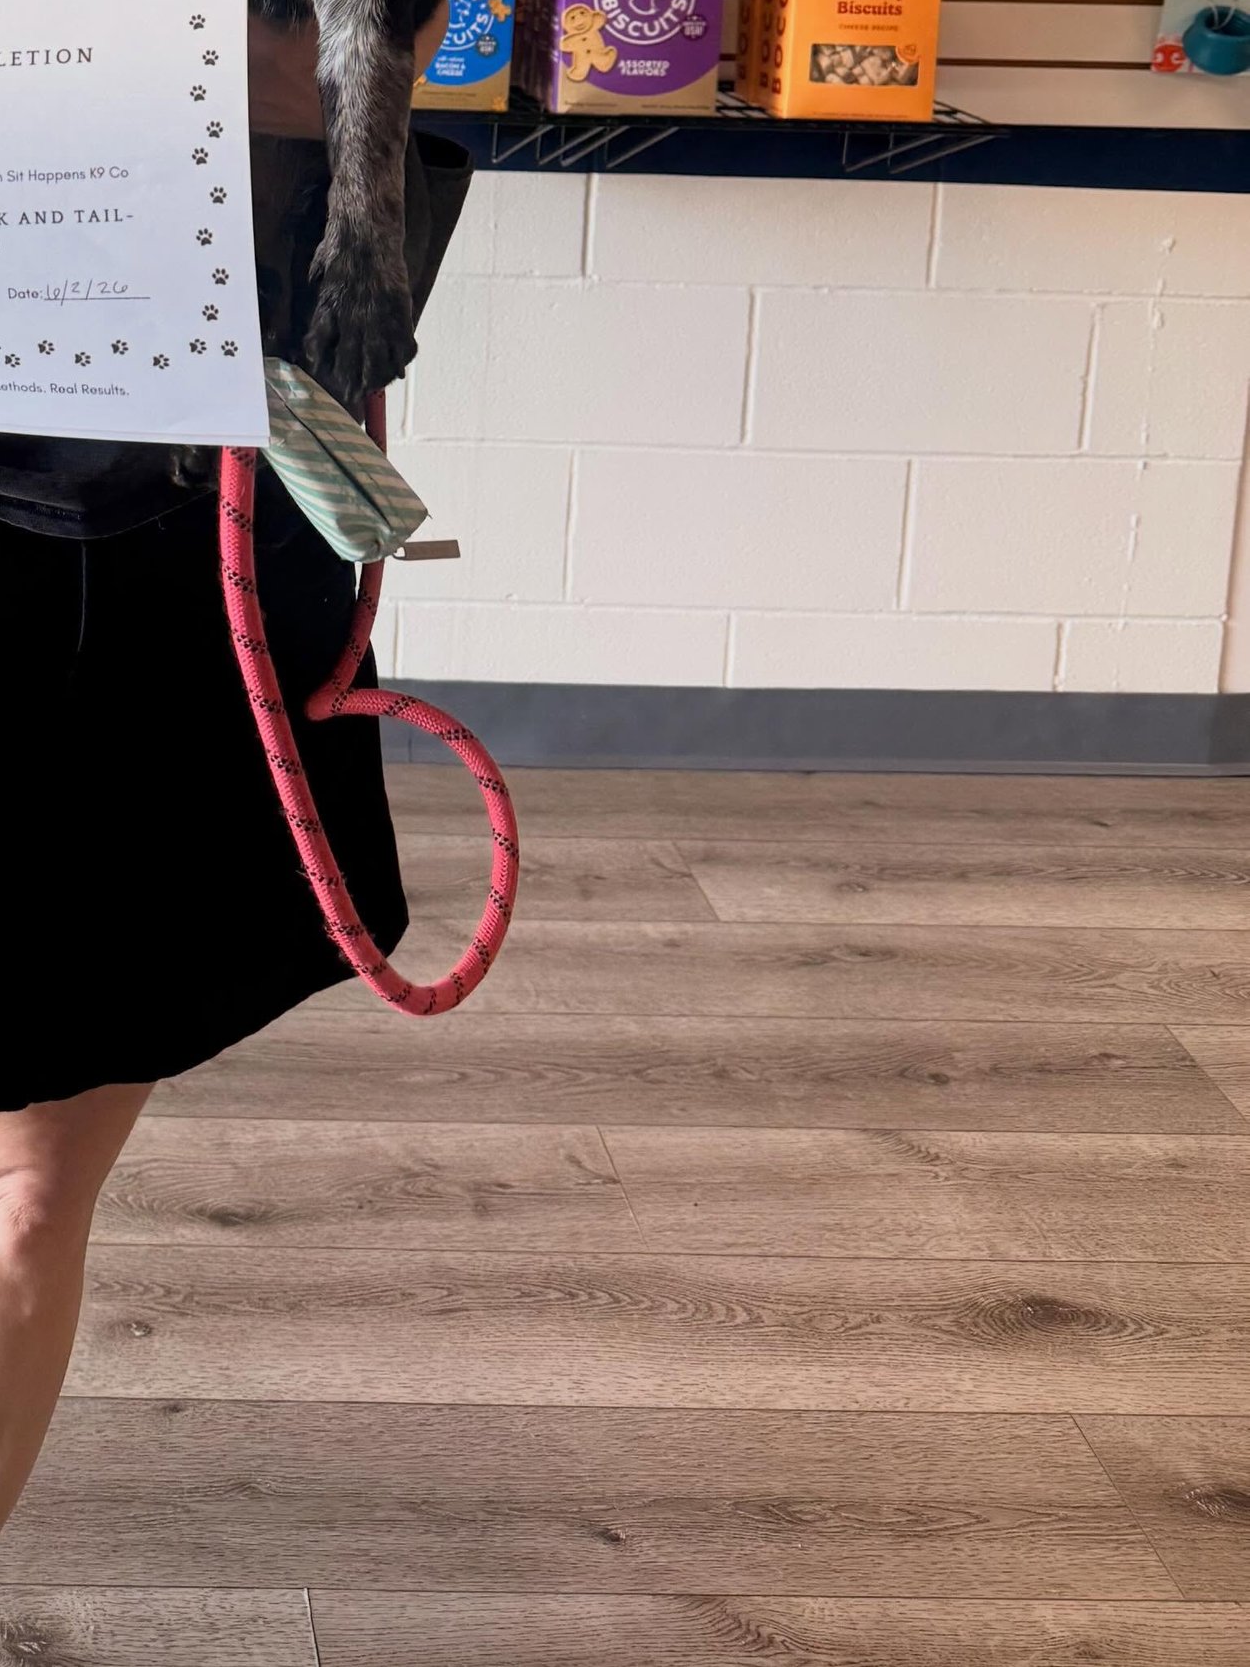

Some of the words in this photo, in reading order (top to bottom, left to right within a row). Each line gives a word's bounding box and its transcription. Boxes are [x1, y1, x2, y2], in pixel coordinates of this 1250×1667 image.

[837, 0, 902, 15] Biscuits
[442, 12, 489, 45] CUITS
[617, 59, 670, 69] ASSORTED
[620, 67, 667, 76] FLAVORS
[6, 169, 24, 183] Sit
[28, 168, 86, 185] Happens
[90, 166, 105, 179] K9
[109, 166, 129, 179] Co
[18, 210, 65, 226] AND
[73, 208, 134, 224] TAIL-
[7, 287, 43, 301] Date:
[50, 383, 78, 395] Real
[81, 384, 130, 397] Results.
